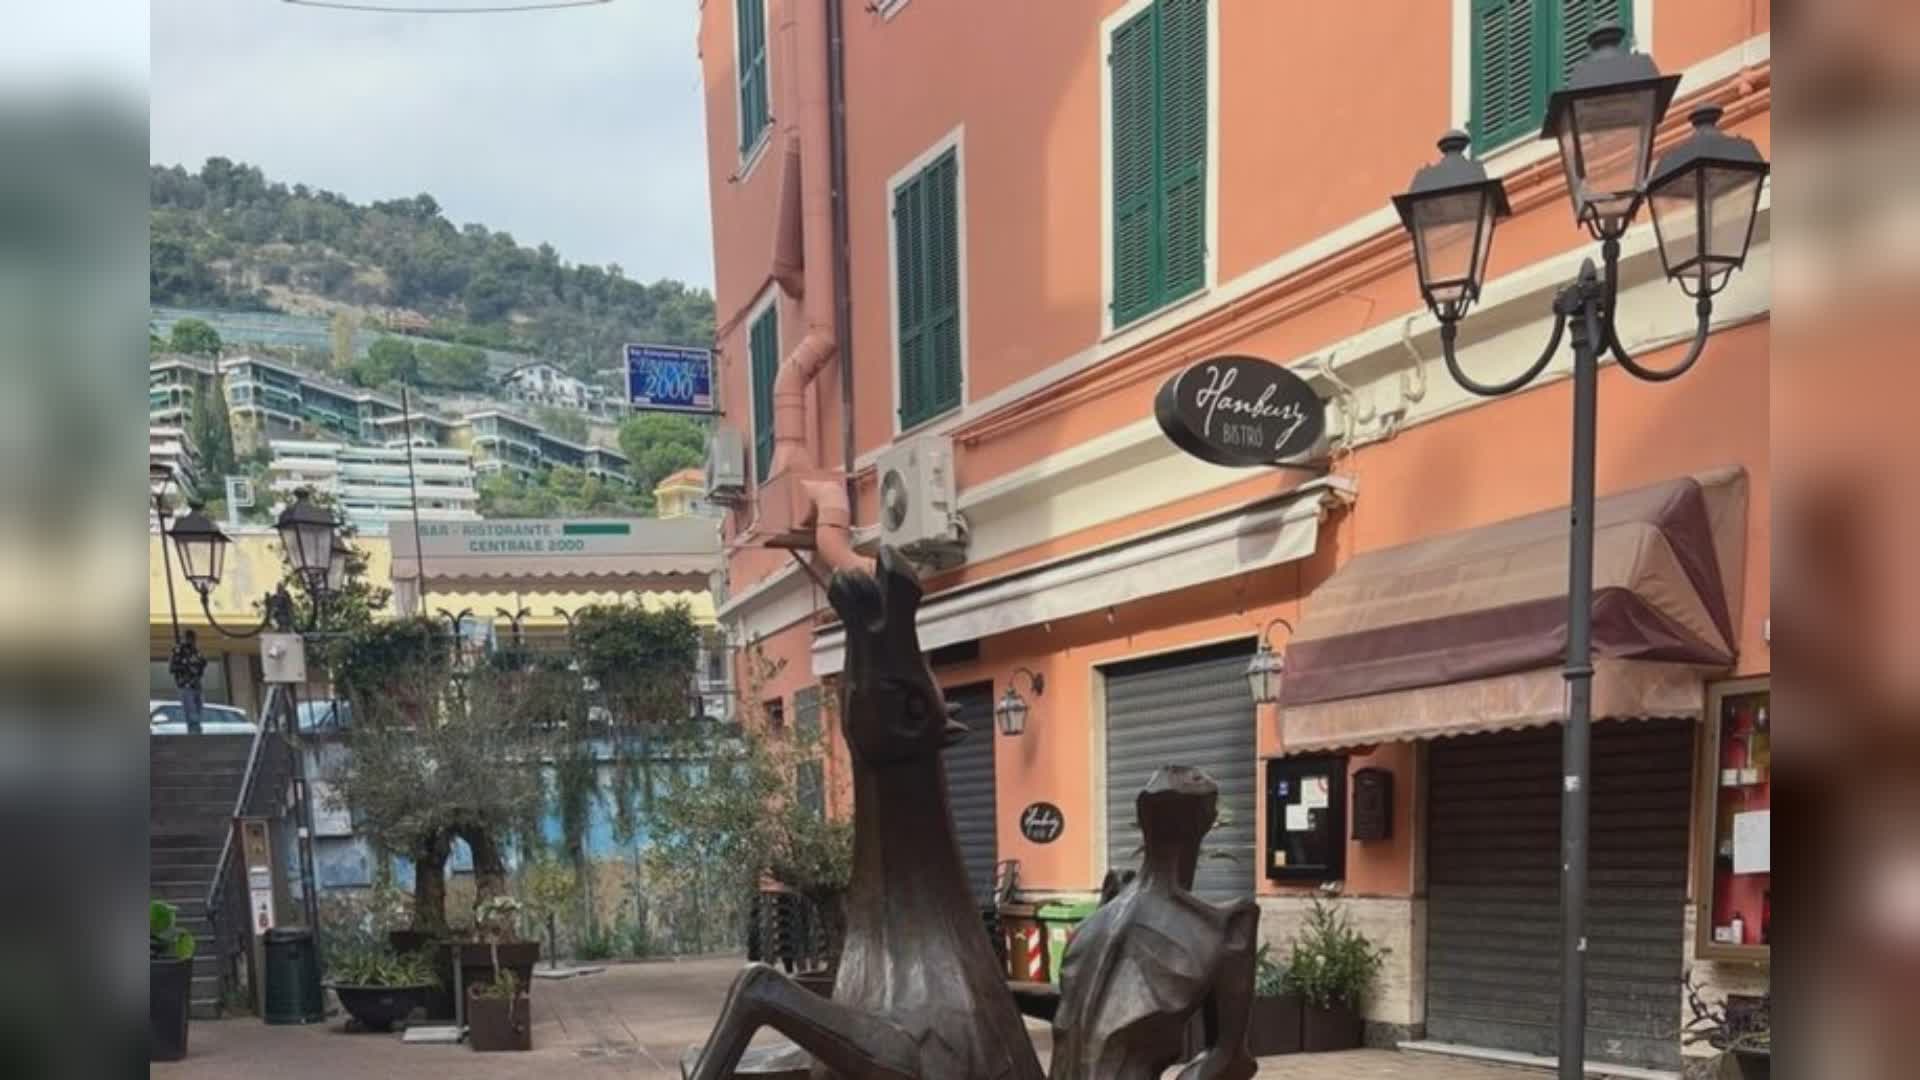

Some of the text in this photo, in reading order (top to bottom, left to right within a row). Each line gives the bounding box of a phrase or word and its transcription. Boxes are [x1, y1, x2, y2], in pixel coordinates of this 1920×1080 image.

[645, 373, 694, 400] 2000
[1196, 365, 1306, 449] Hanbury
[419, 525, 448, 537] BAR
[462, 524, 551, 537] RISTORANTE
[469, 539, 585, 552] CENTRALE 2000
